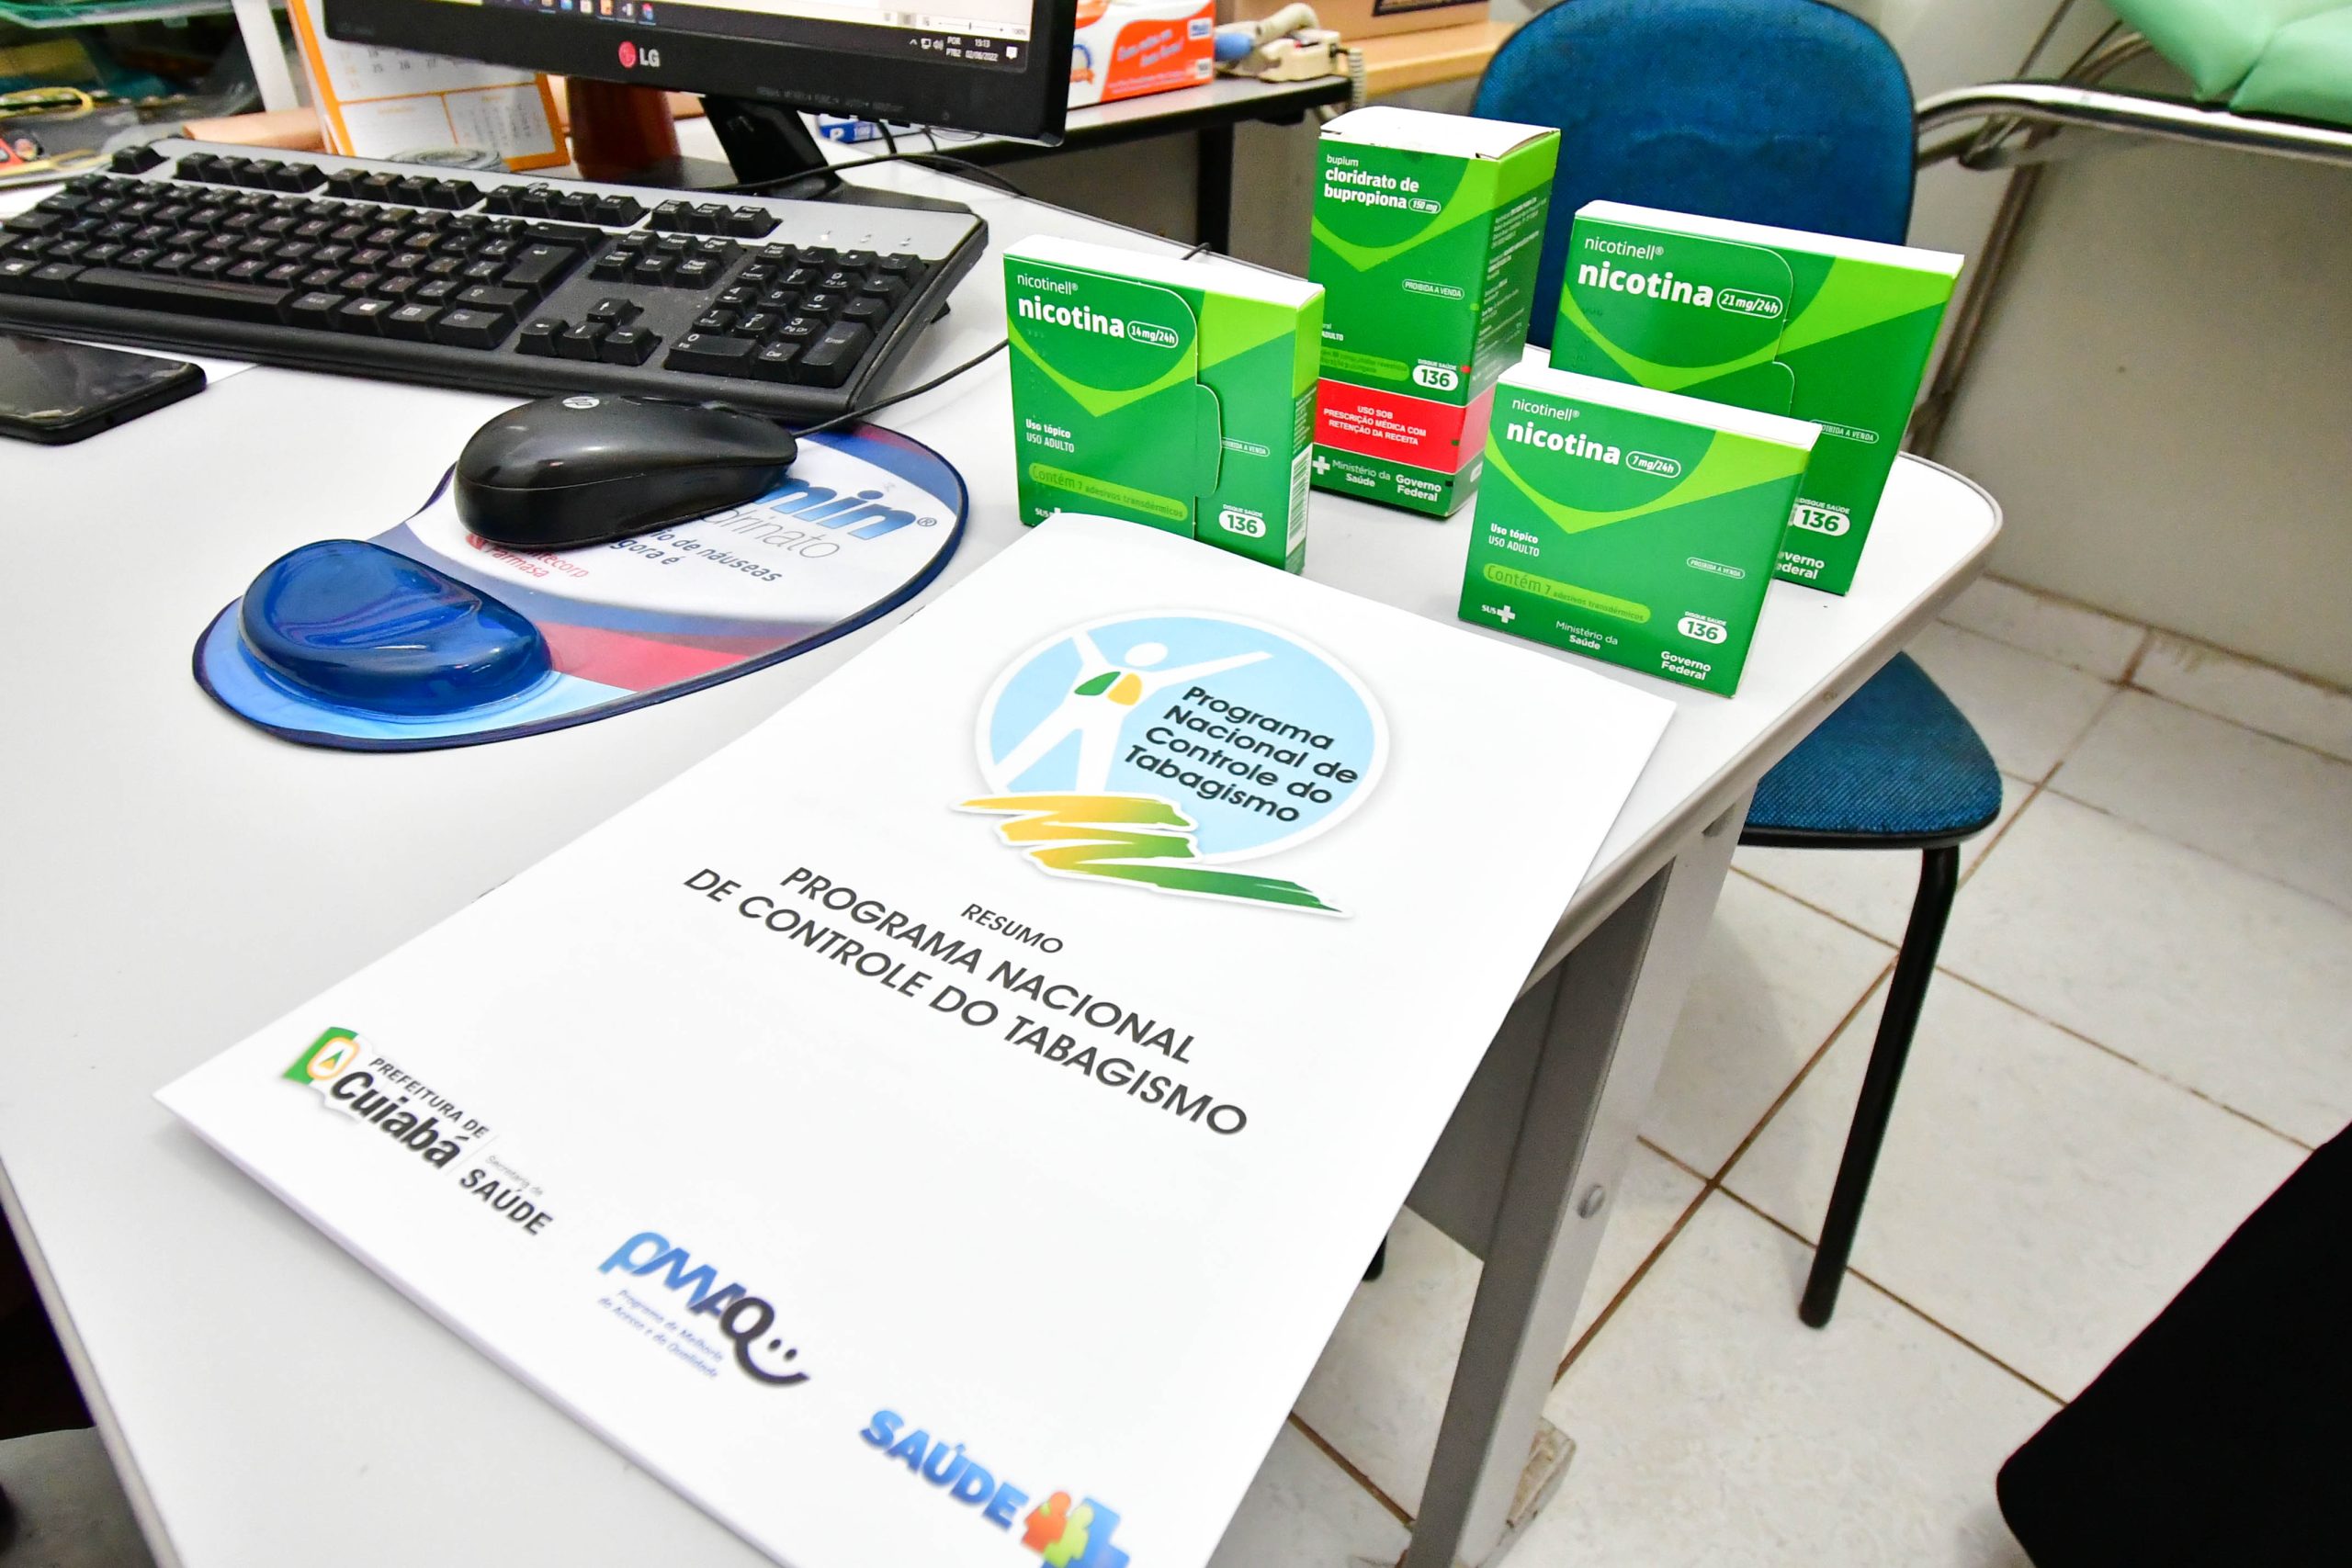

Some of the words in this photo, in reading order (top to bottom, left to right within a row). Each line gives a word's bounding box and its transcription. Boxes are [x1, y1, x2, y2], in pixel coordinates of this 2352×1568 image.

[639, 47, 660, 67] LG
[1327, 153, 1359, 167] bupium
[1325, 167, 1396, 191] cloridrato
[1400, 176, 1419, 193] de
[1324, 184, 1407, 209] bupropiona
[1411, 199, 1426, 210] 150
[1426, 202, 1438, 213] mg
[1405, 281, 1433, 293] PROIBIDA
[1439, 287, 1462, 298] VENDA
[1577, 260, 1714, 309] nicotina
[1018, 296, 1125, 338] nicotina
[688, 333, 699, 342] 0
[1421, 369, 1450, 388] 136
[1324, 409, 1372, 426] PRESCRIÇÃO
[1375, 418, 1406, 433] MÉDICA
[1408, 426, 1426, 436] COM
[1357, 405, 1374, 415] USO
[1375, 409, 1393, 420] SOB
[1025, 419, 1042, 431] Uso
[1044, 423, 1070, 438] tópico
[1329, 419, 1370, 436] RETENÇÃO
[1372, 428, 1383, 438] DA
[1385, 431, 1419, 446] RECEITA
[1822, 423, 1844, 435] OIBIDA
[1852, 430, 1873, 442] VENDA
[1026, 432, 1042, 445] USO
[1044, 436, 1075, 453] ADULTO
[1506, 421, 1621, 466] nicotina
[1033, 465, 1075, 489] Contém
[1332, 459, 1376, 478] Ministério
[1378, 470, 1390, 481] da
[1345, 472, 1375, 488] Saúde
[1396, 474, 1442, 493] Governo
[1396, 485, 1438, 502] Federal
[1223, 504, 1244, 513] DISQUE
[1799, 498, 1826, 509] DISQUE
[1826, 503, 1850, 514] SAÚDE
[1227, 514, 1258, 535] 136
[1803, 509, 1839, 532] 136
[1490, 523, 1507, 536] Uso
[1510, 529, 1539, 544] tópico
[609, 539, 664, 559] gora
[662, 556, 687, 565] é
[1488, 535, 1505, 547] USO
[1507, 540, 1540, 558] ADULTO
[487, 547, 549, 578] armasa
[672, 539, 701, 552] de
[698, 548, 782, 581] náuseas
[1690, 558, 1716, 571] PROIBIDA
[1723, 568, 1740, 578] VENDA
[1487, 565, 1542, 592] Contém
[1545, 584, 1552, 595] 7
[1554, 591, 1587, 606] adesivos
[1589, 600, 1644, 621] transdérmicos
[1481, 604, 1497, 615] SUS
[1685, 611, 1706, 620] DISQUE
[1555, 620, 1603, 640] Ministério
[1605, 634, 1618, 645] da
[1687, 621, 1718, 640] 136
[1569, 635, 1600, 650] Saúde
[1661, 651, 1711, 671] Governo
[1661, 660, 1706, 681] Federal
[1182, 686, 1335, 750] Programa
[1163, 705, 1308, 768] Nacional
[1313, 761, 1358, 783] de
[1146, 727, 1279, 786] Controle
[1287, 782, 1331, 804] do
[1125, 745, 1299, 822] Tabagismo
[960, 903, 1063, 953] RESUMO
[780, 866, 982, 974] PROGRAMA
[987, 960, 1194, 1064] NACIONAL
[684, 868, 741, 903] DE
[739, 896, 933, 997] CONTROLE
[929, 985, 999, 1026] DO
[1003, 1015, 1247, 1135] TABAGISMO
[368, 1057, 464, 1122] PREFEITURA
[463, 1118, 490, 1139] DE
[330, 1071, 469, 1169] Cuiabá
[459, 1168, 553, 1235] SAÚDE
[859, 1410, 1029, 1532] SAÚDE
